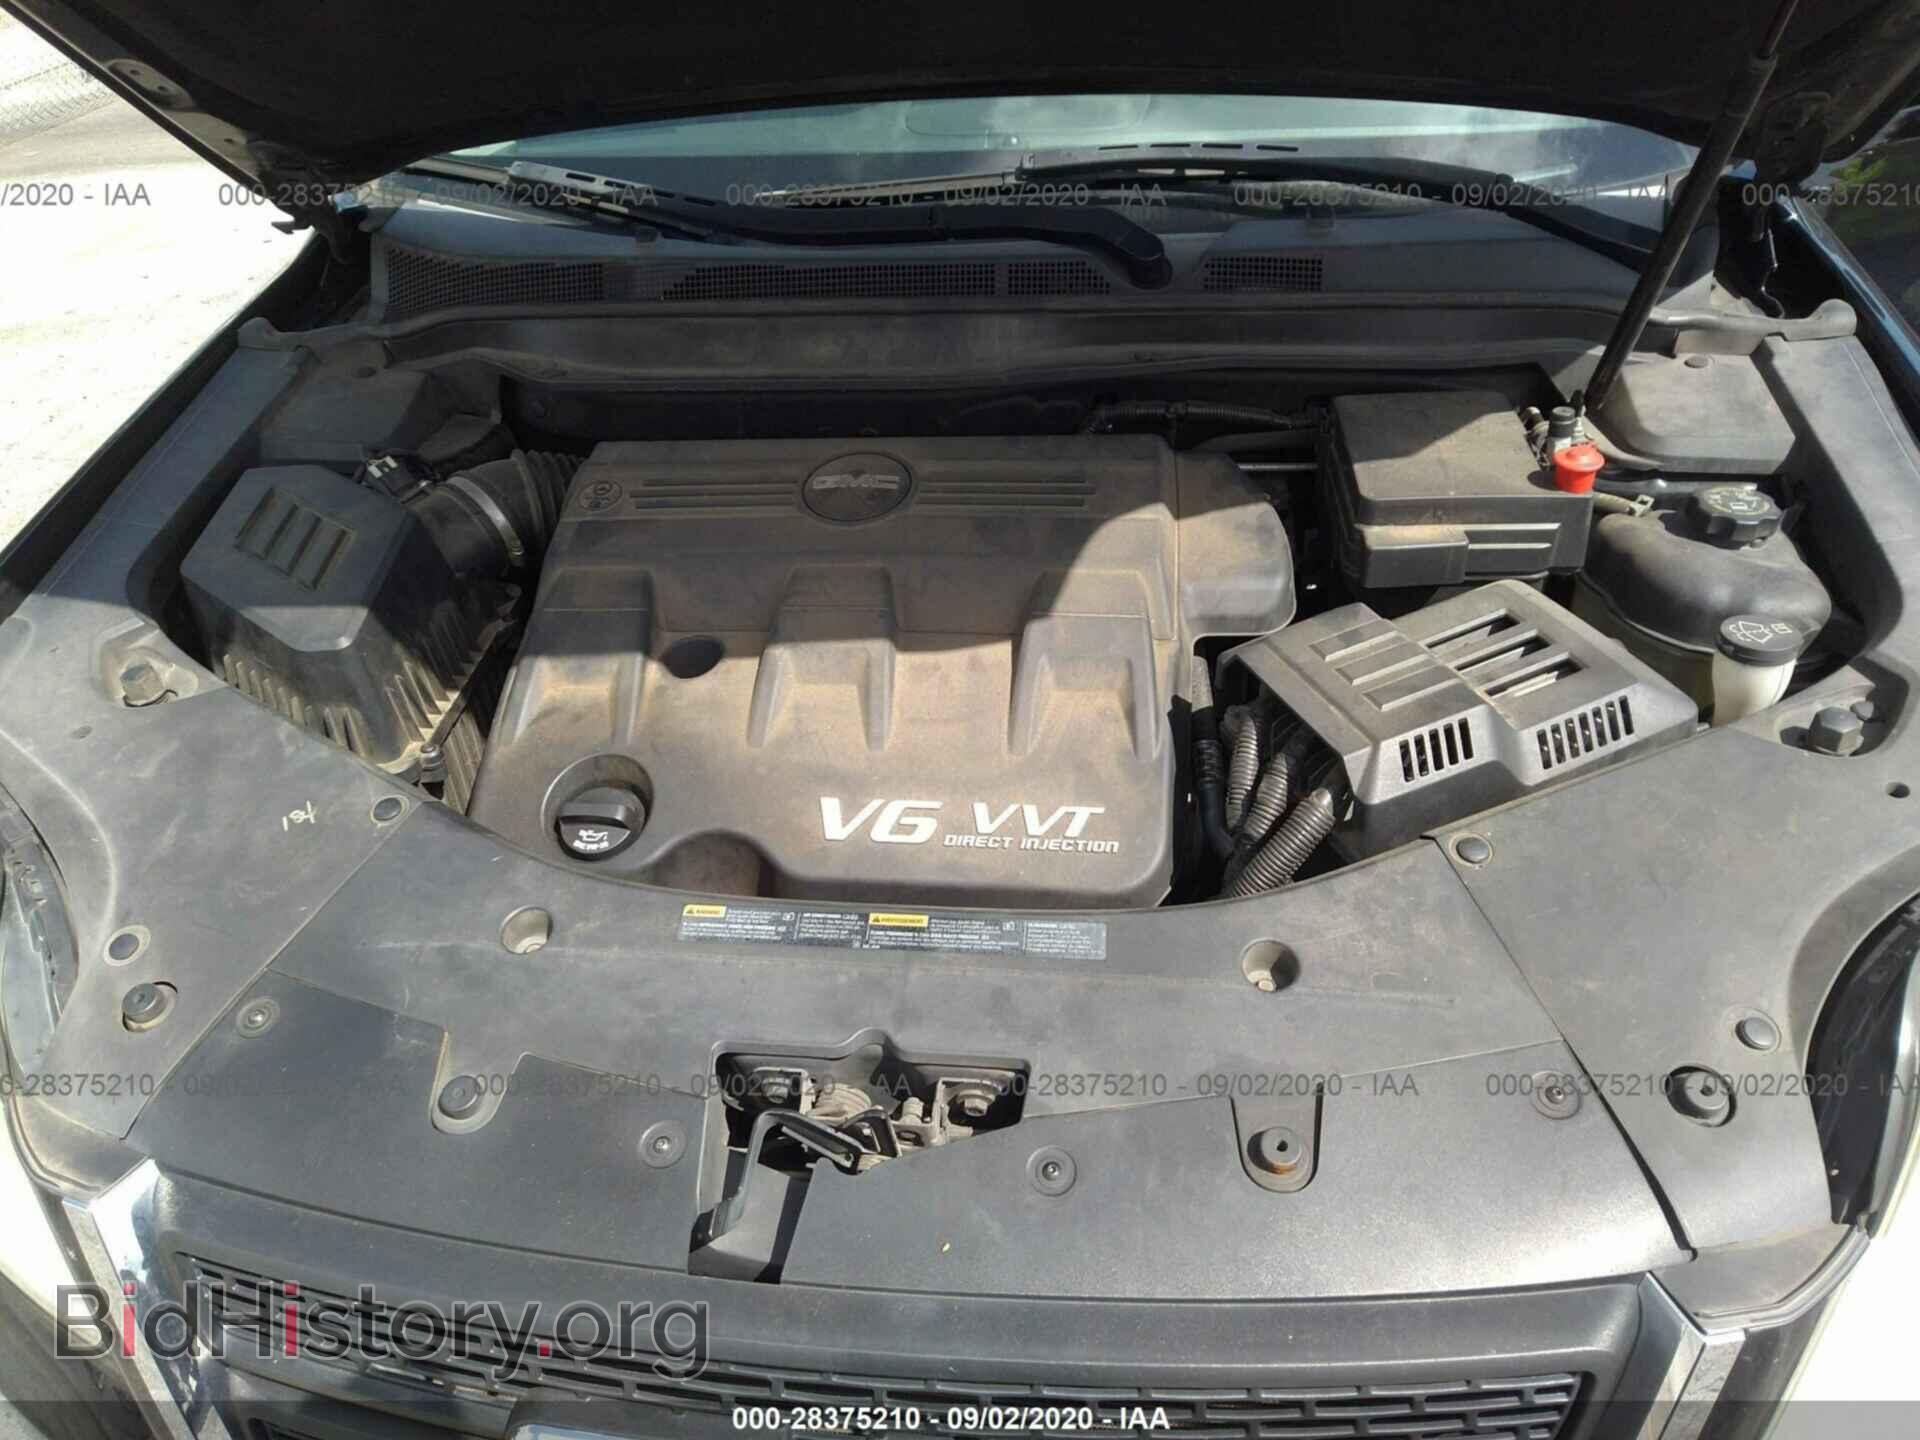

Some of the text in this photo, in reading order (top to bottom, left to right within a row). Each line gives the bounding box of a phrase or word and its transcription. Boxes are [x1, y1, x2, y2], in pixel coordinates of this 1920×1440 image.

[819, 796, 1106, 844] V6 VVT
[943, 833, 1120, 853] DIRECT INJECTION
